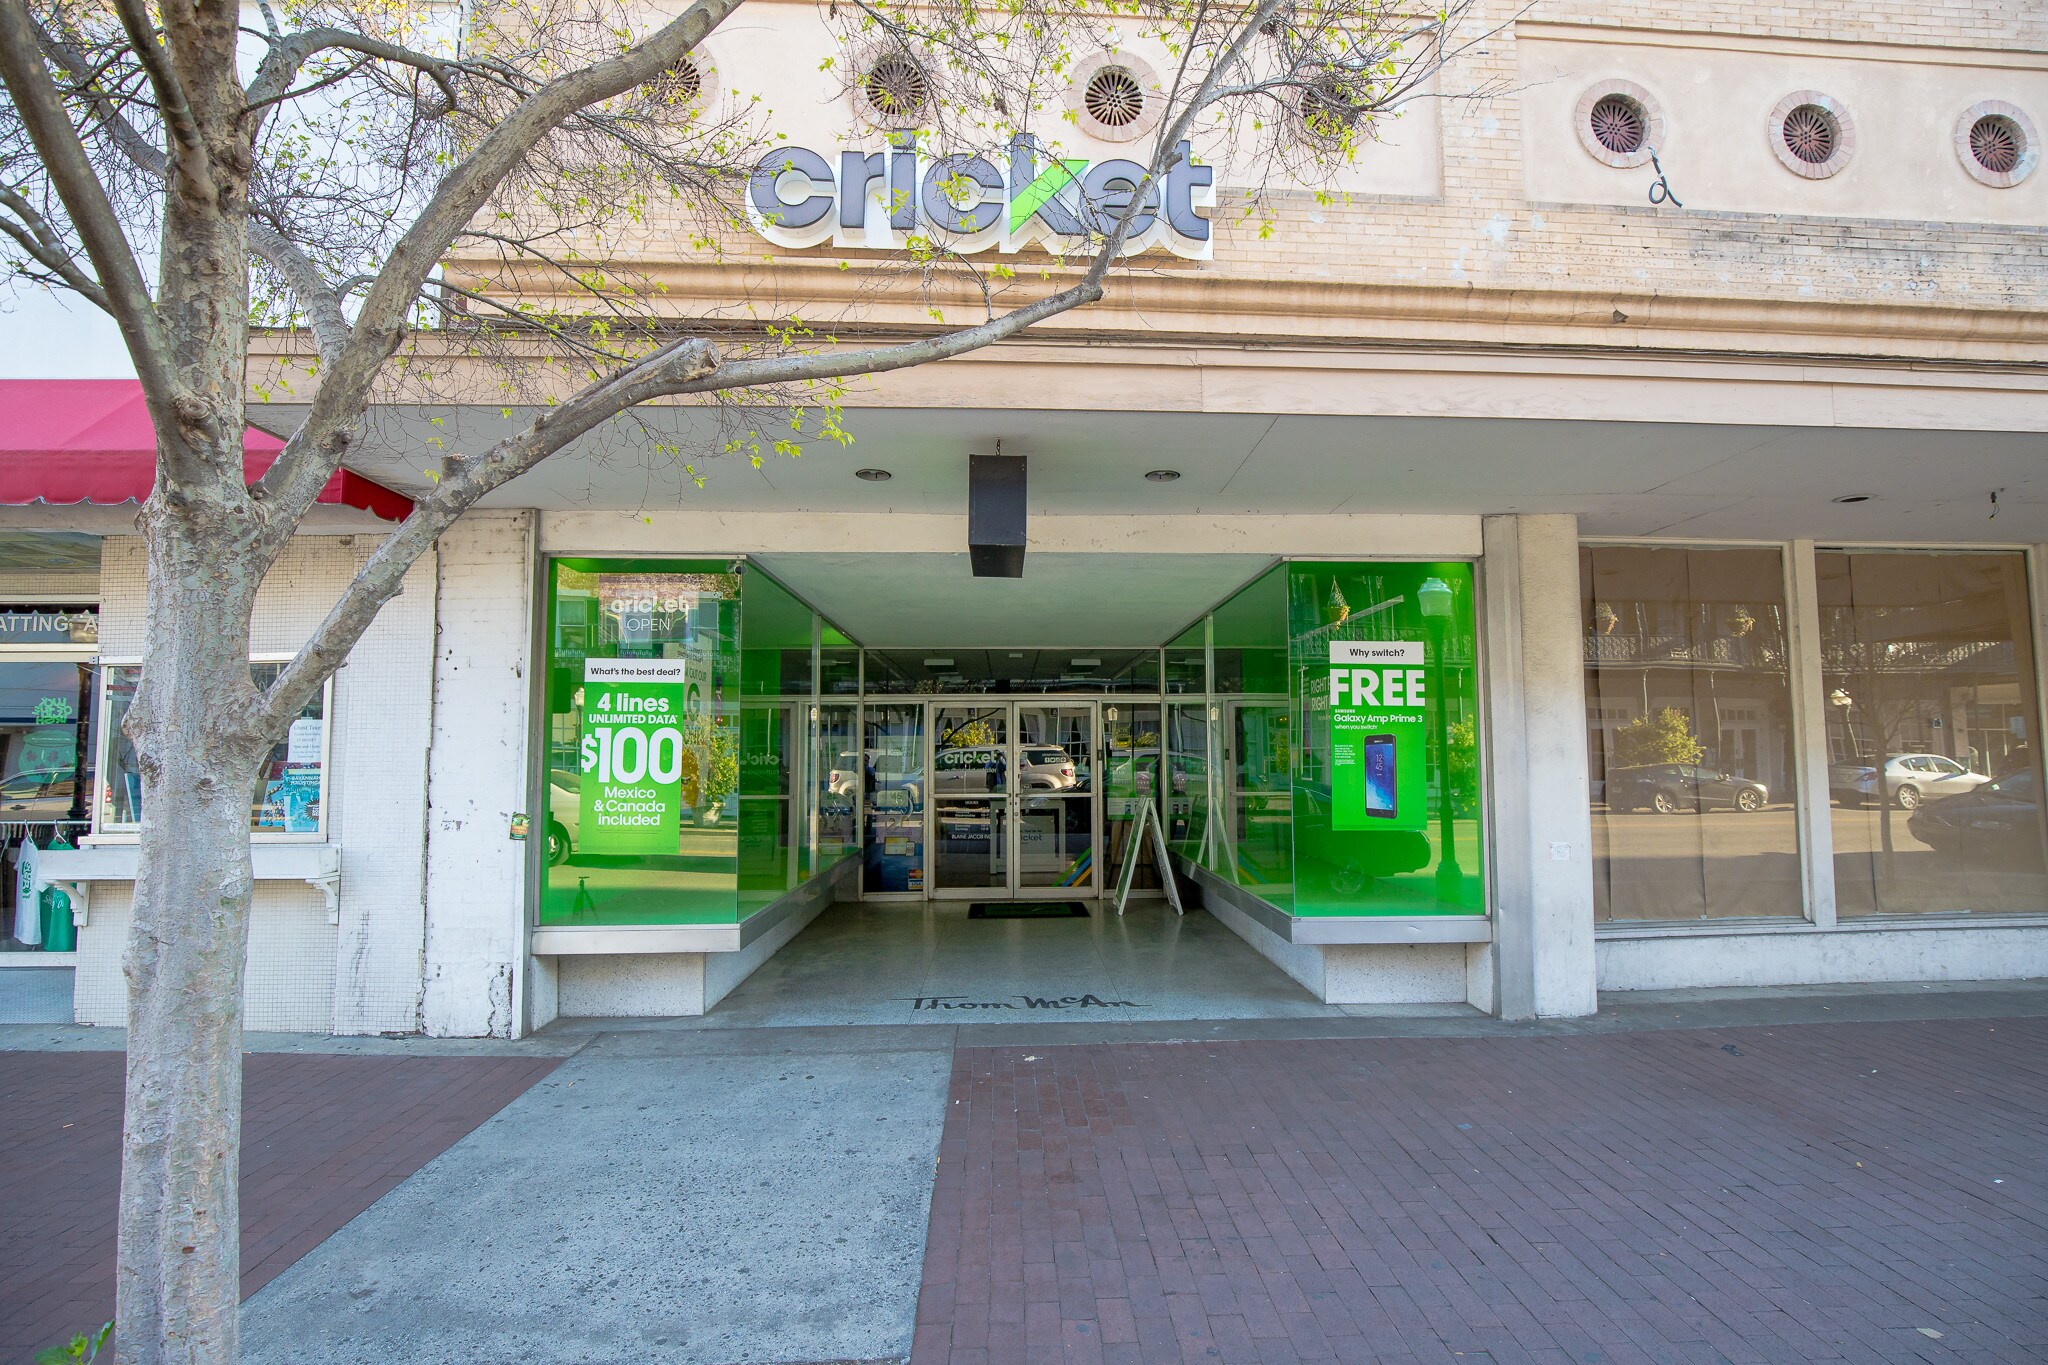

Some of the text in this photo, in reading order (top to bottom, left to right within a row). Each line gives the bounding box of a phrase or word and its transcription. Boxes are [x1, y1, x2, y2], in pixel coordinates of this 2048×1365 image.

[747, 126, 1214, 250] cricket
[610, 595, 689, 614] cricket
[626, 618, 670, 631] OPEN
[1349, 648, 1405, 658] Why switch?
[590, 667, 620, 675] What's
[656, 668, 681, 676] deal?
[1310, 676, 1327, 694] RIGHT
[1329, 668, 1426, 707] FREE
[597, 692, 670, 712] 4 lines
[1311, 695, 1329, 711] RIGHT
[588, 713, 647, 724] UNLIMITED
[1333, 713, 1366, 724] Galaxy
[1366, 714, 1389, 725] Amp
[1390, 713, 1417, 723] Prime
[1417, 715, 1423, 723] 3
[580, 726, 683, 784] $100
[944, 751, 997, 764] cricket
[1376, 754, 1383, 762] 12
[1375, 763, 1383, 771] 45
[604, 786, 656, 799] Mexico
[593, 799, 666, 812] & Canada
[597, 813, 660, 826] included
[891, 996, 1022, 1010] Thom
